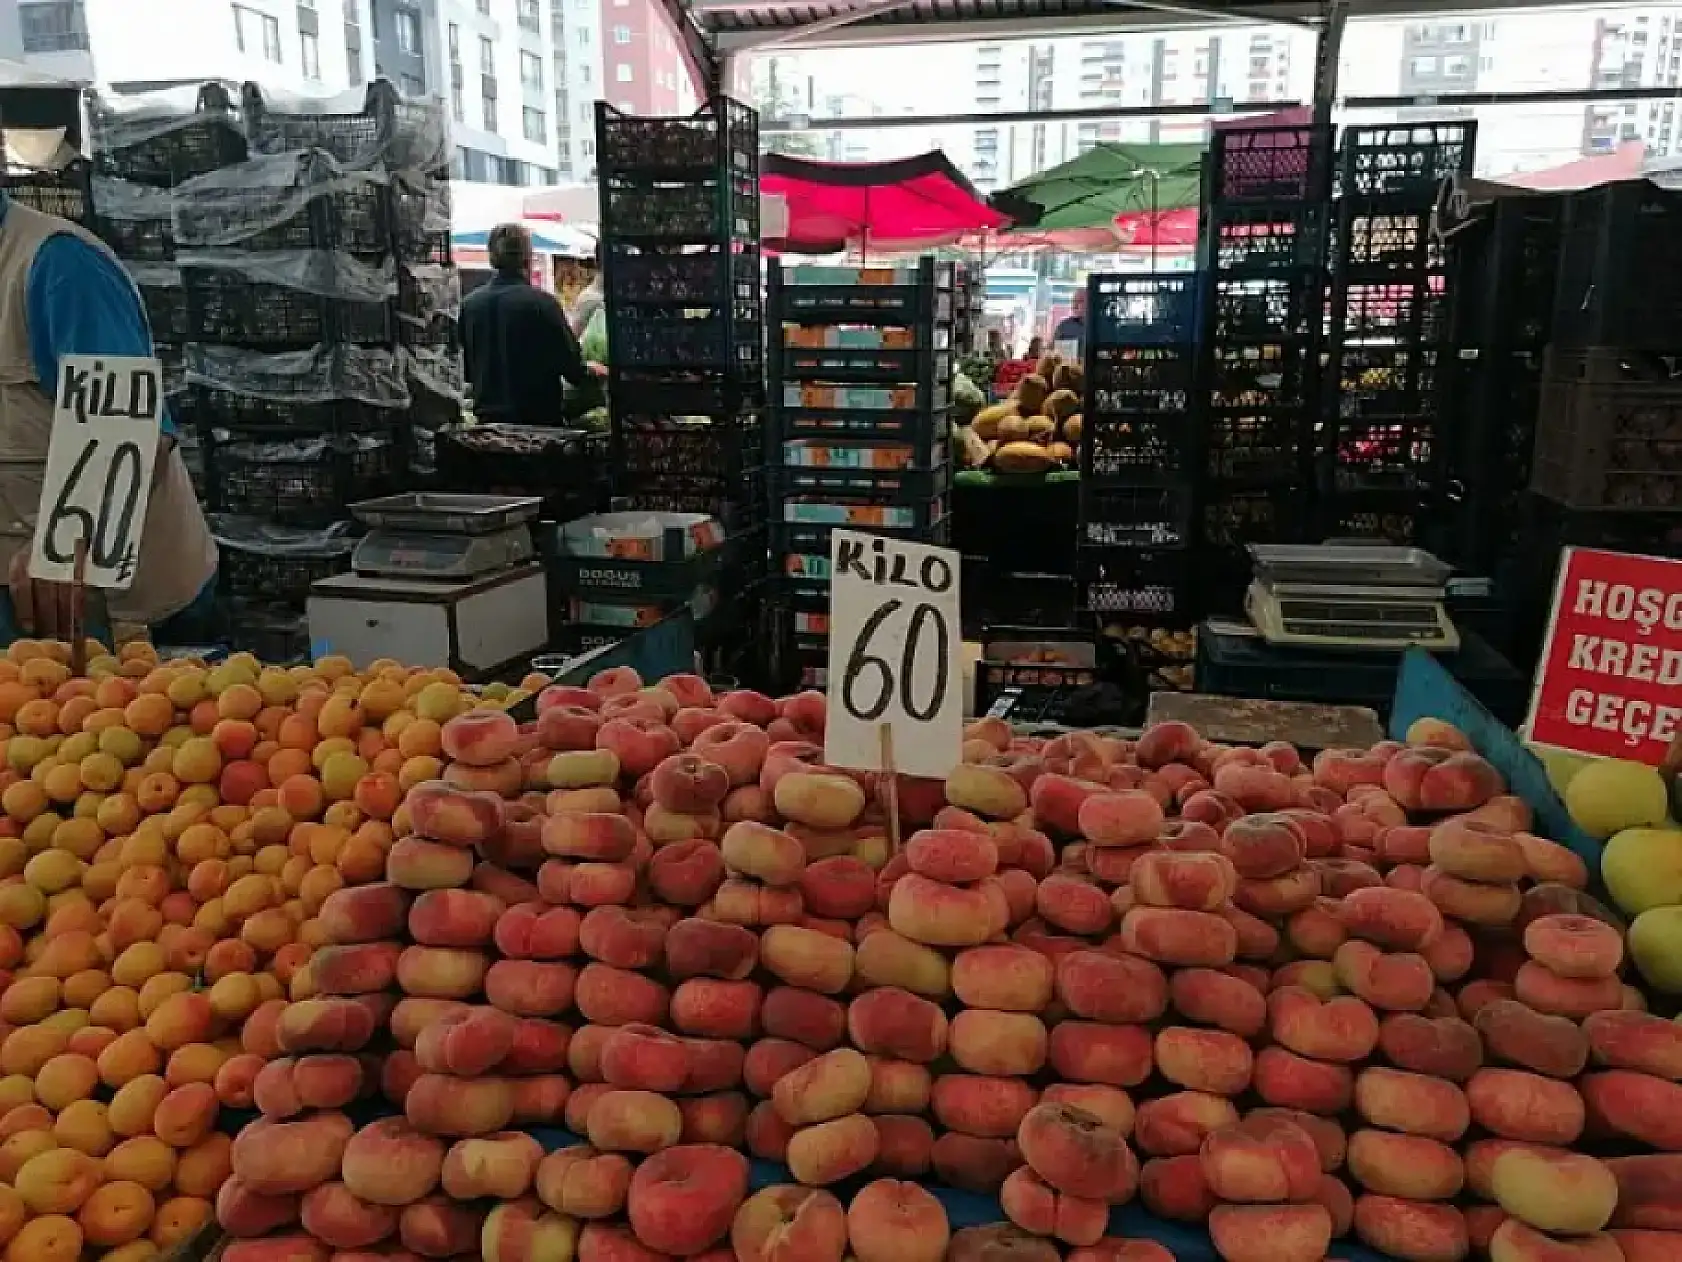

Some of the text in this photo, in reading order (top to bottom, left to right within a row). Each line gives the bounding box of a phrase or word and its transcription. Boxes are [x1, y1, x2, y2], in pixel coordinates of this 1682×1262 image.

[843, 598, 949, 721] 60
[1567, 634, 1682, 685] KRED
[1566, 688, 1682, 746] GEÇE
